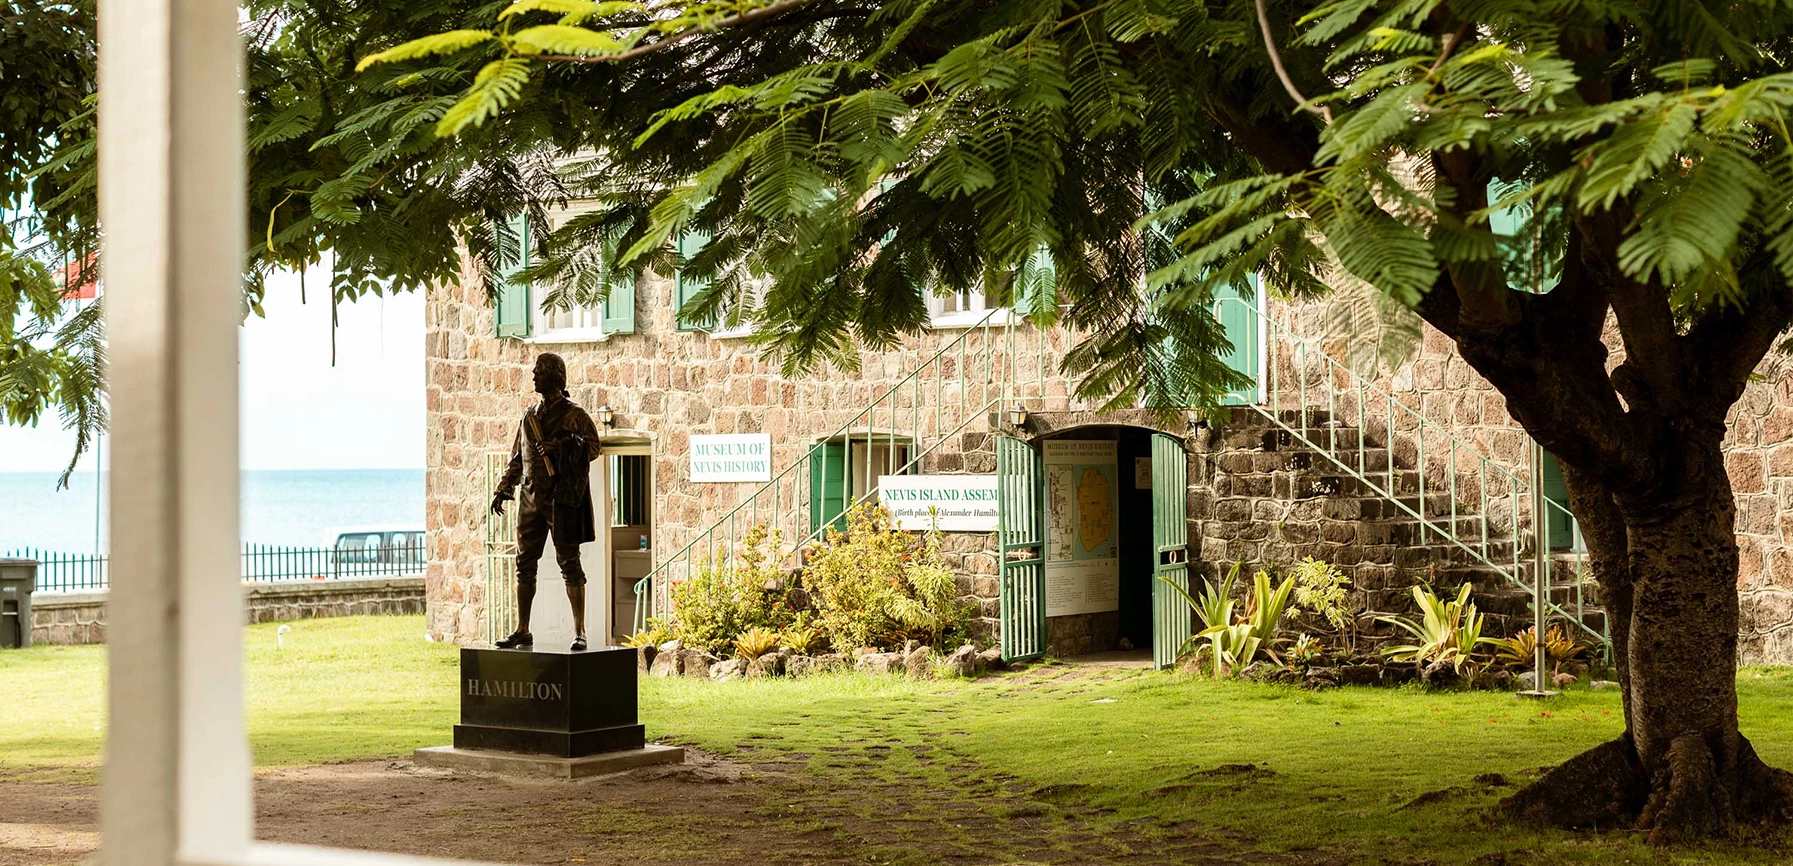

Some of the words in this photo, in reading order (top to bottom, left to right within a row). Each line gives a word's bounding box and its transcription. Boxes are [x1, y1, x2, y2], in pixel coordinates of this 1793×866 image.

[695, 443, 746, 456] MUSEUM
[749, 442, 766, 455] OF
[693, 461, 722, 473] NEVIS
[724, 460, 768, 473] HISTORY
[885, 488, 917, 501] NEVIS
[919, 488, 960, 501] ISLAND
[961, 488, 998, 501] ASSEM
[894, 508, 914, 517] (Birth
[940, 508, 972, 517] Alexander
[973, 508, 1001, 517] Hamilto
[467, 678, 562, 700] HAMILTON
